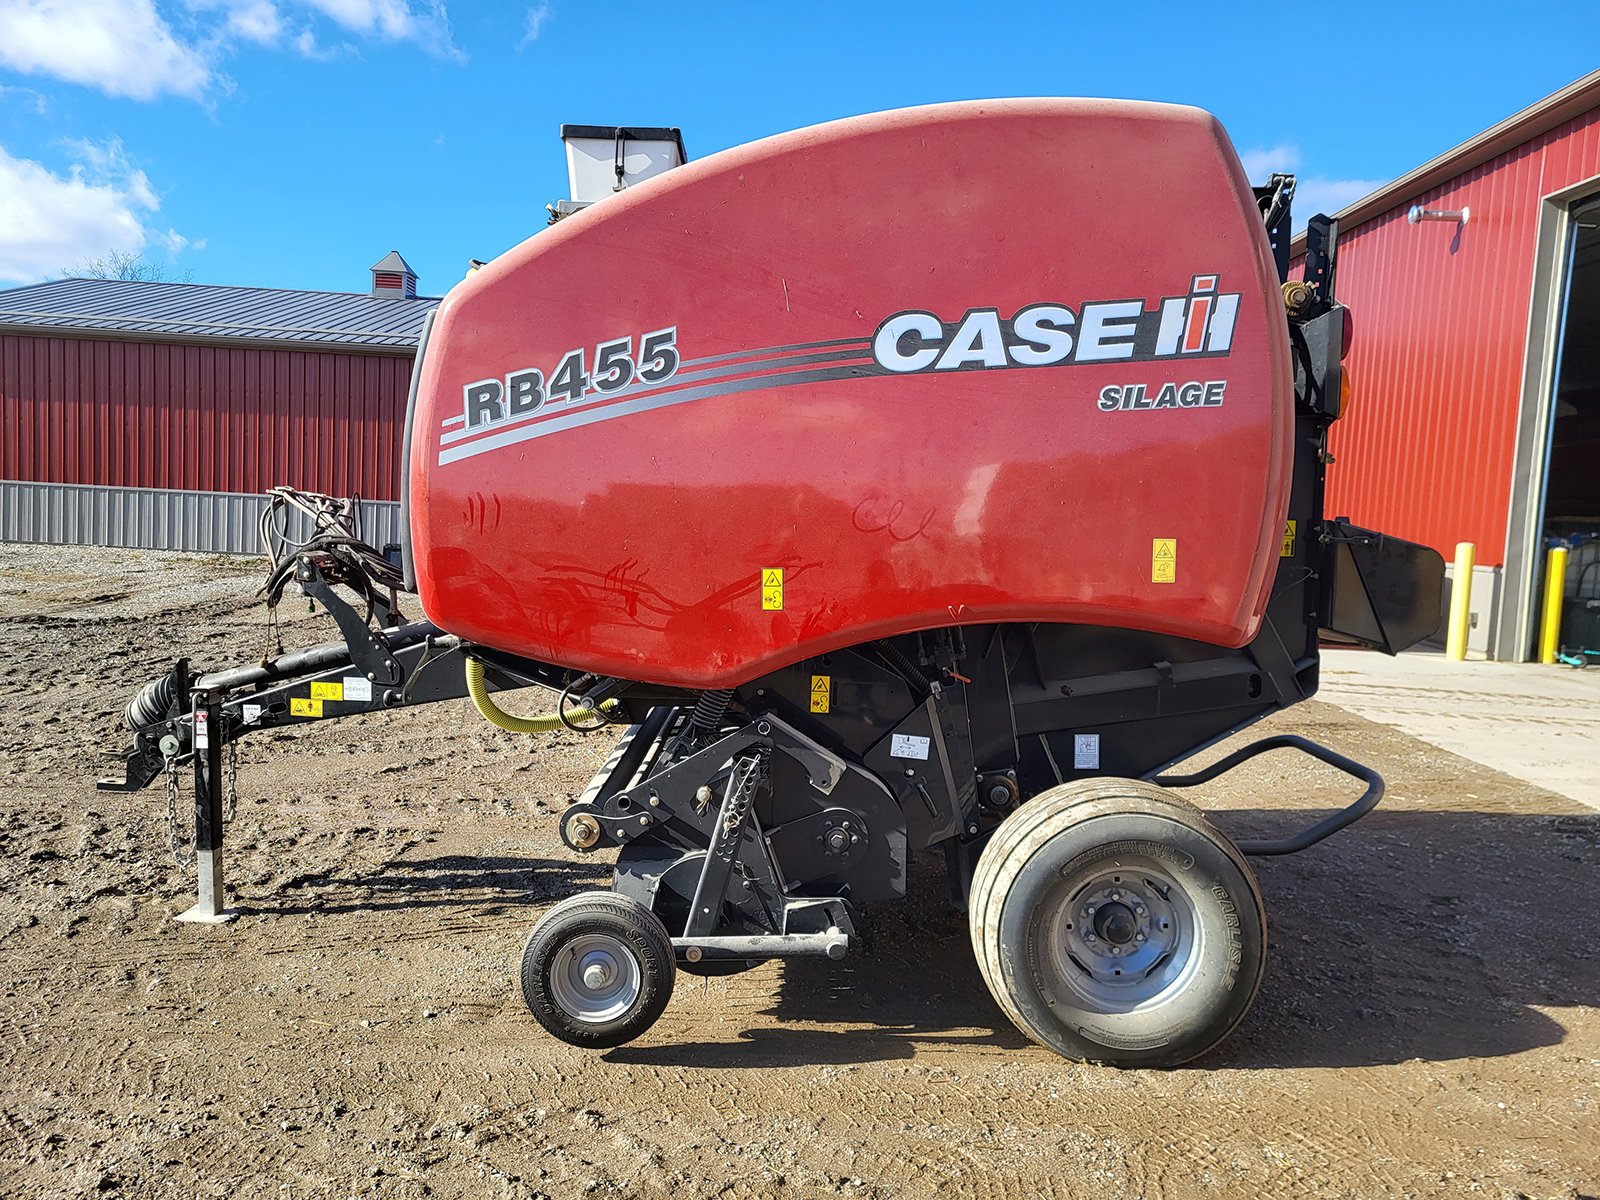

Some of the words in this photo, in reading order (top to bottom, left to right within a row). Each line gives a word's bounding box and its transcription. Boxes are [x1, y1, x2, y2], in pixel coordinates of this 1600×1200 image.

[874, 302, 1144, 372] CASE
[462, 326, 680, 430] RB455
[1097, 380, 1227, 412] SILAGE
[530, 932, 560, 1016] CARLISLE
[625, 928, 659, 981] SPORT
[1210, 884, 1244, 992] CARLISLE
